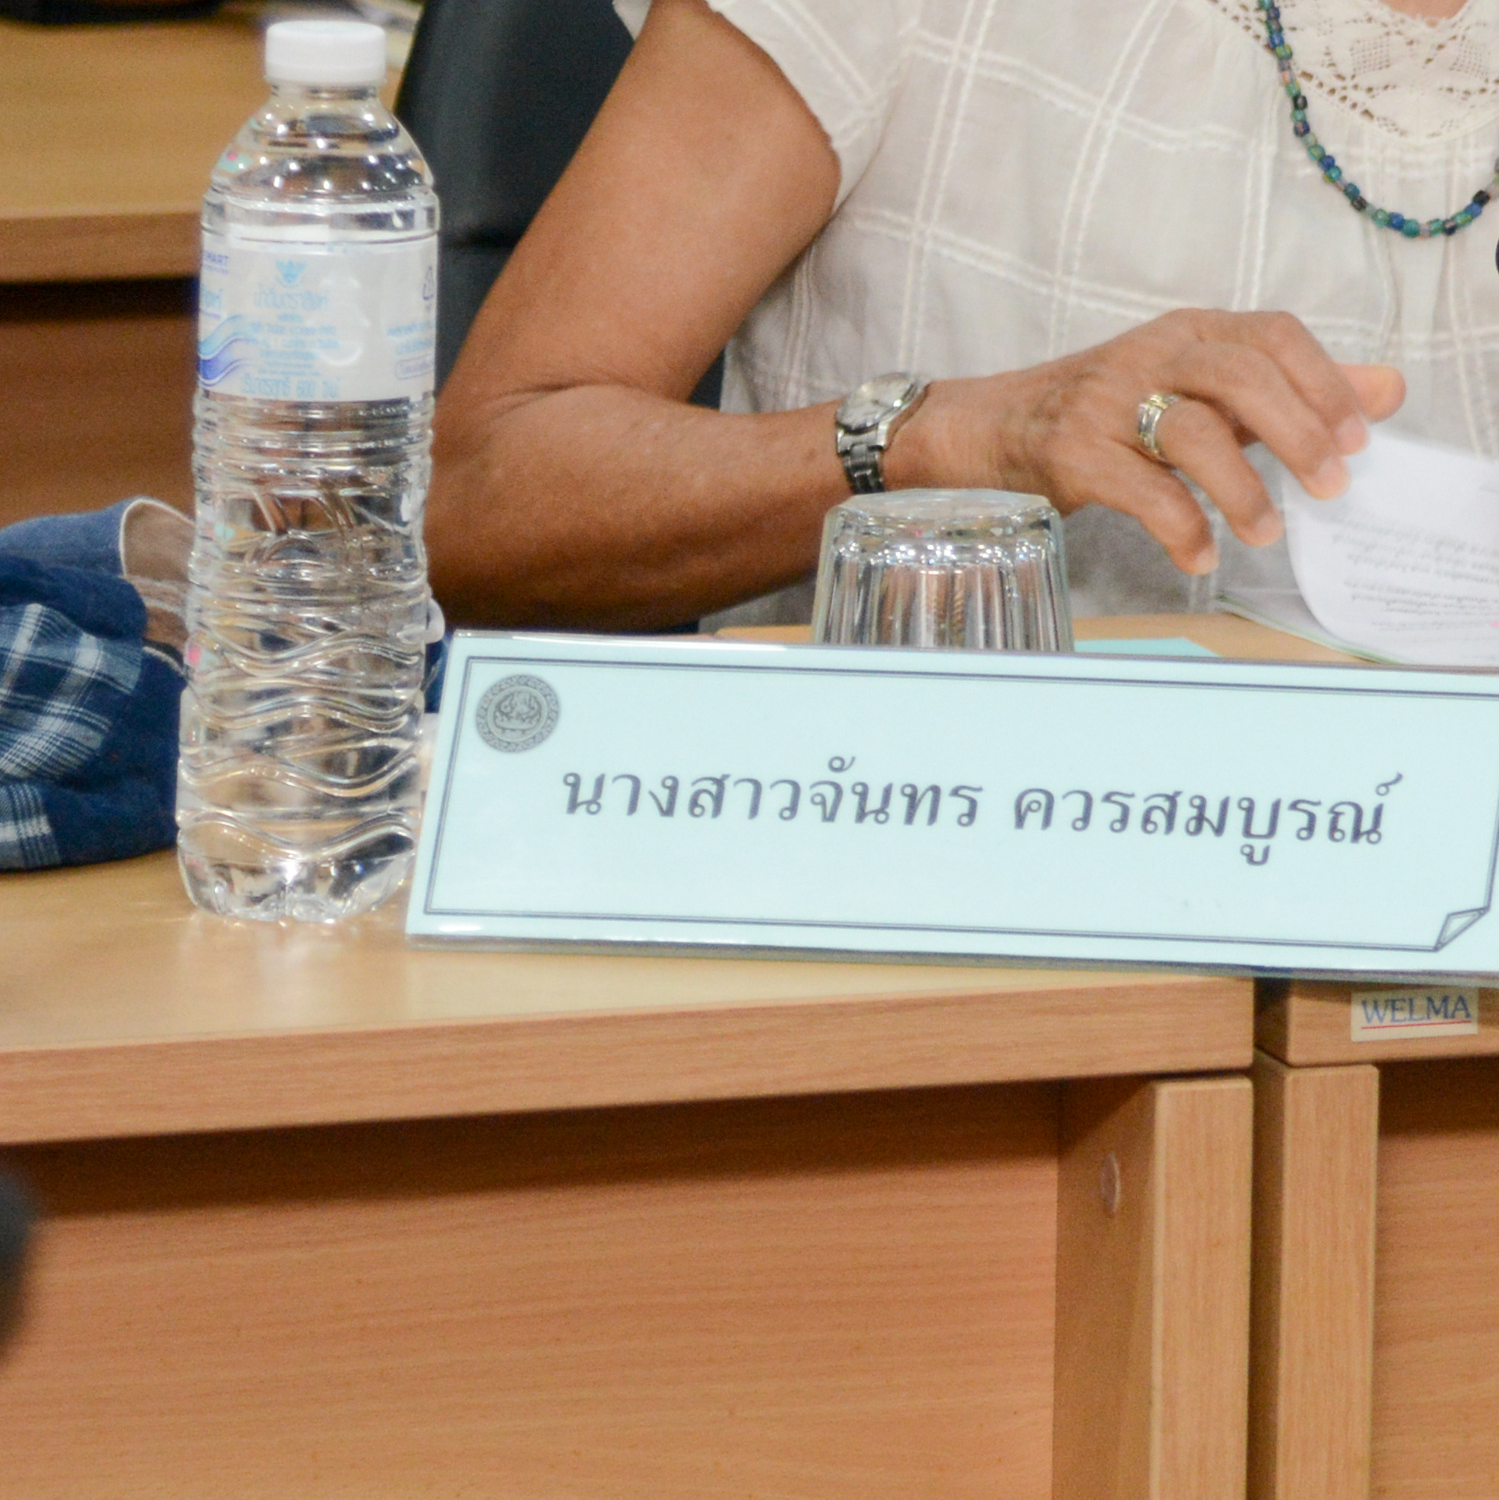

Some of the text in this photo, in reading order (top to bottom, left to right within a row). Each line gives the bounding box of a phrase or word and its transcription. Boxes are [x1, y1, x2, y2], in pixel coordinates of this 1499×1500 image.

[562, 755, 1404, 867] นางสาวจันทร ควรสมบูรณ์
[1361, 995, 1471, 1024] WELMA
